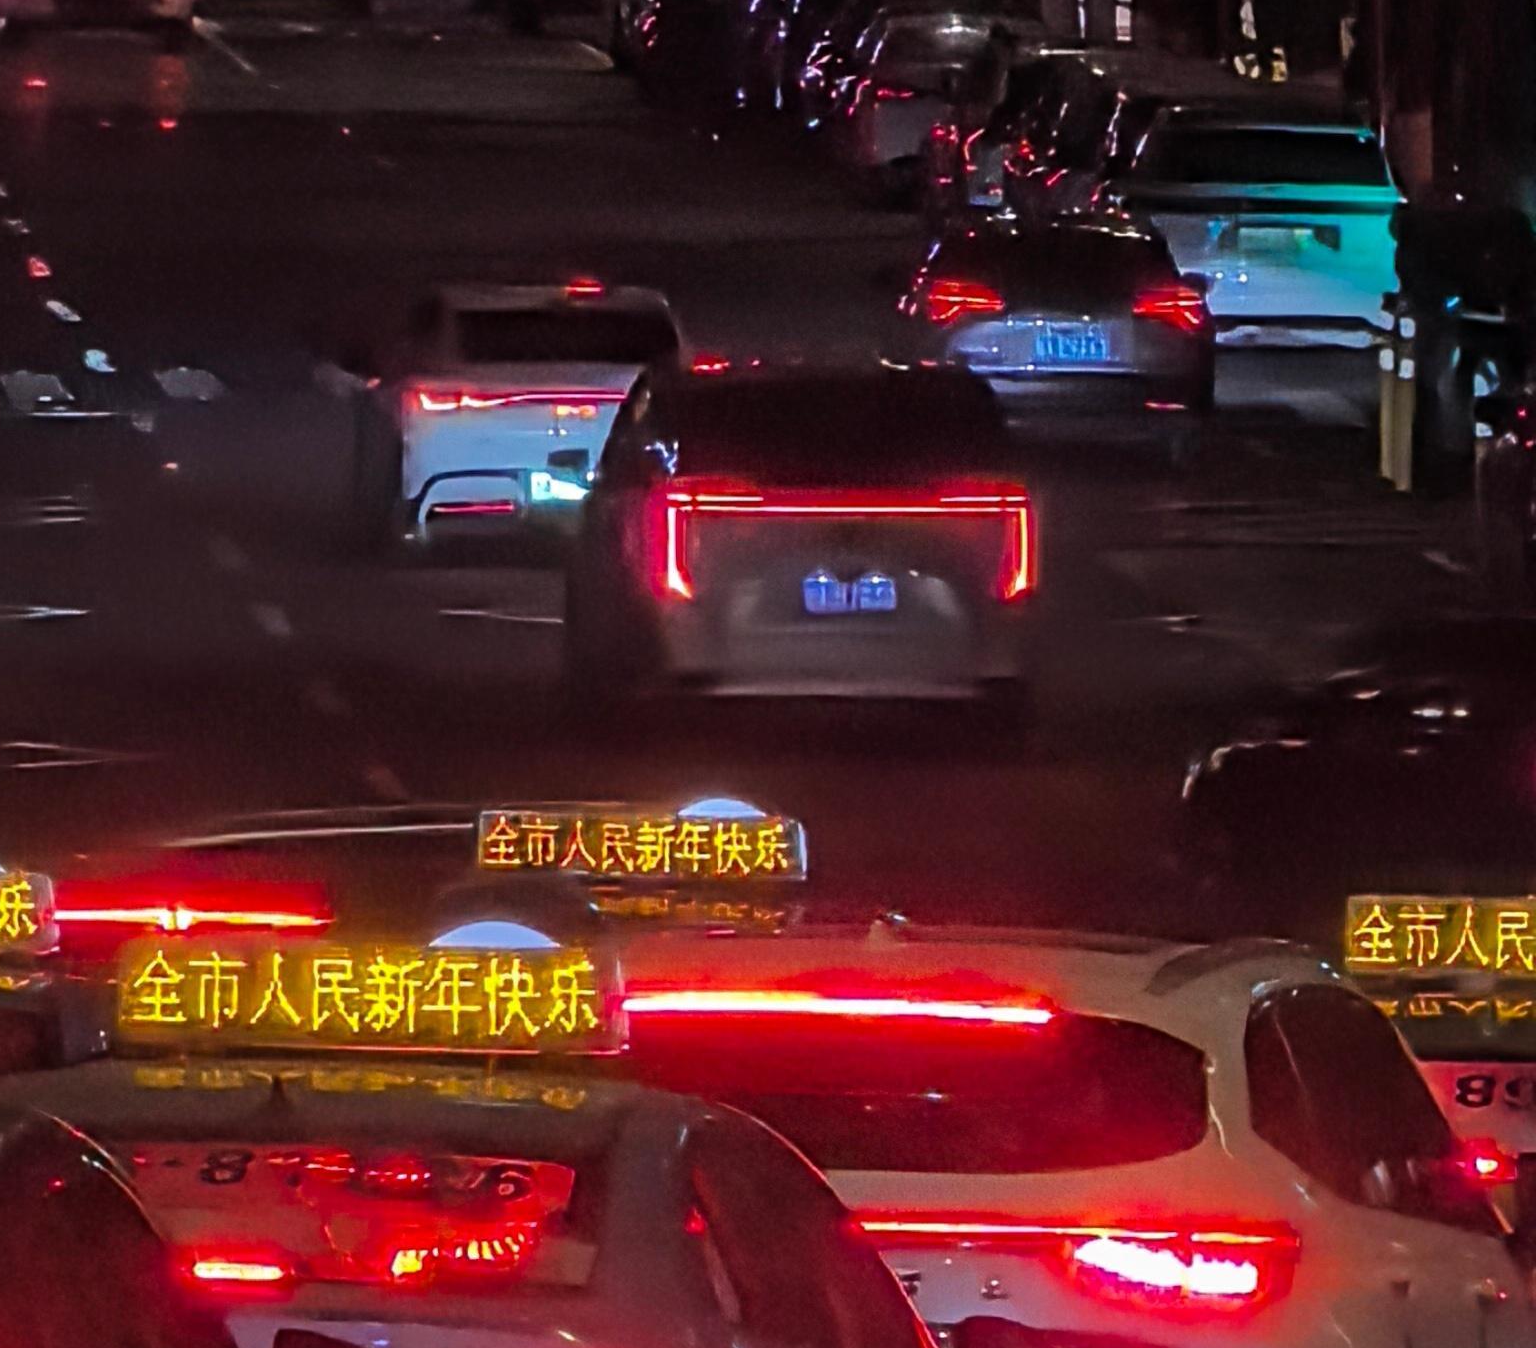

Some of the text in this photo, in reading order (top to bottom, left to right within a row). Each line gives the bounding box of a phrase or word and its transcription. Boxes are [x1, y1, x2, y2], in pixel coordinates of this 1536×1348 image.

[484, 813, 789, 874] 全市人民新年快乐
[1345, 903, 1536, 971] 全市人民
[128, 948, 600, 1038] 全市人民新年快乐
